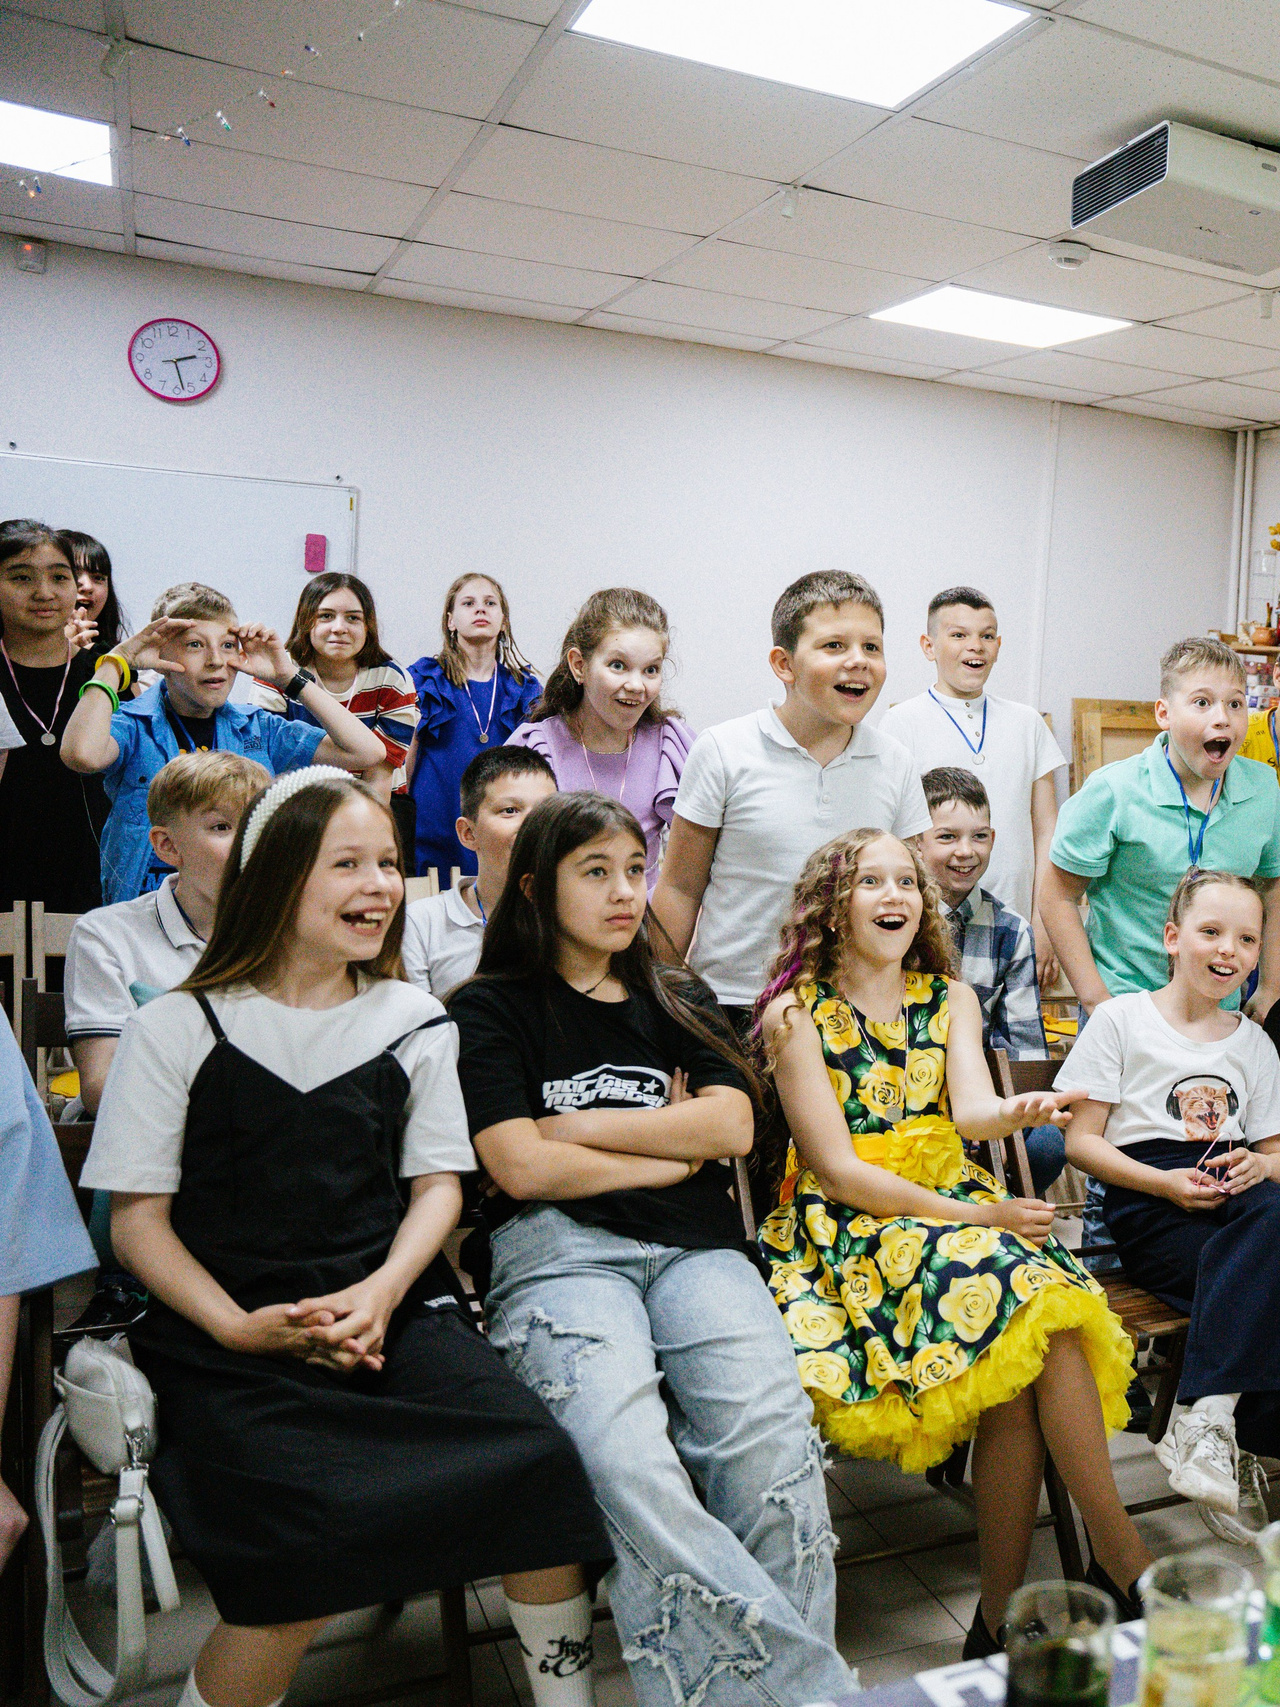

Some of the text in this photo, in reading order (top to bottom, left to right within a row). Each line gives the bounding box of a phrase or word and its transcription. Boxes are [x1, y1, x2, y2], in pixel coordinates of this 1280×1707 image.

[152, 327, 162, 339] 11
[167, 325, 179, 337] 12
[140, 337, 155, 349] 10
[197, 340, 207, 352] 2
[135, 352, 145, 364] 9
[204, 356, 213, 368] 3
[143, 368, 152, 380] 8
[199, 372, 208, 383] 4
[158, 380, 167, 391] 7
[172, 384, 182, 396] 6
[187, 382, 196, 394] 5
